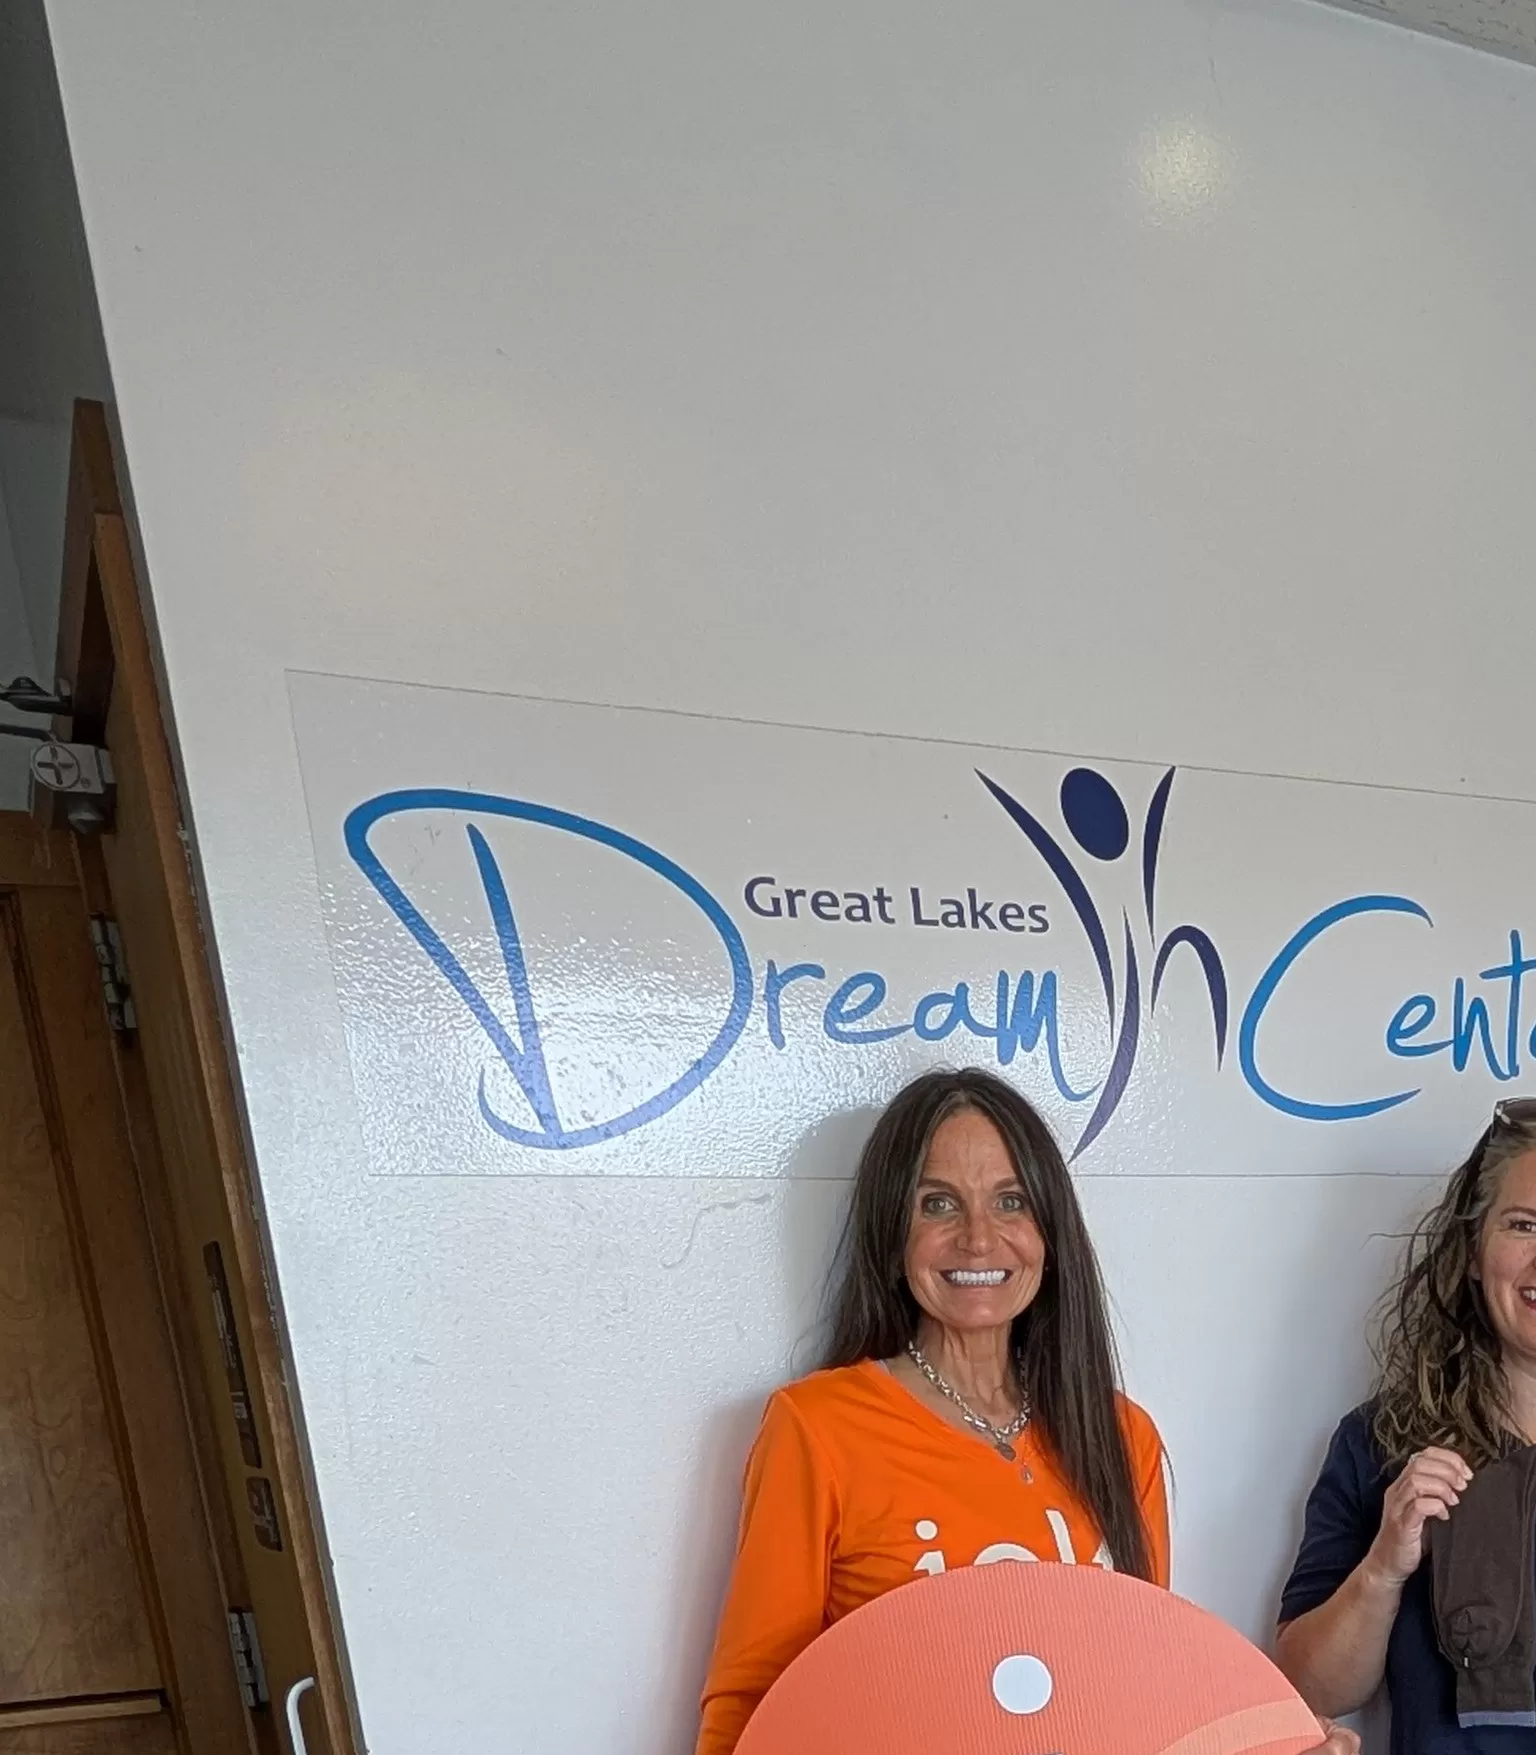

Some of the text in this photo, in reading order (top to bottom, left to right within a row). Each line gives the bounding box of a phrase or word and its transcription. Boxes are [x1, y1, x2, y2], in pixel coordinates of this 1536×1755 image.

[344, 788, 1100, 1151] Dream
[743, 875, 1051, 936] Great Lakes
